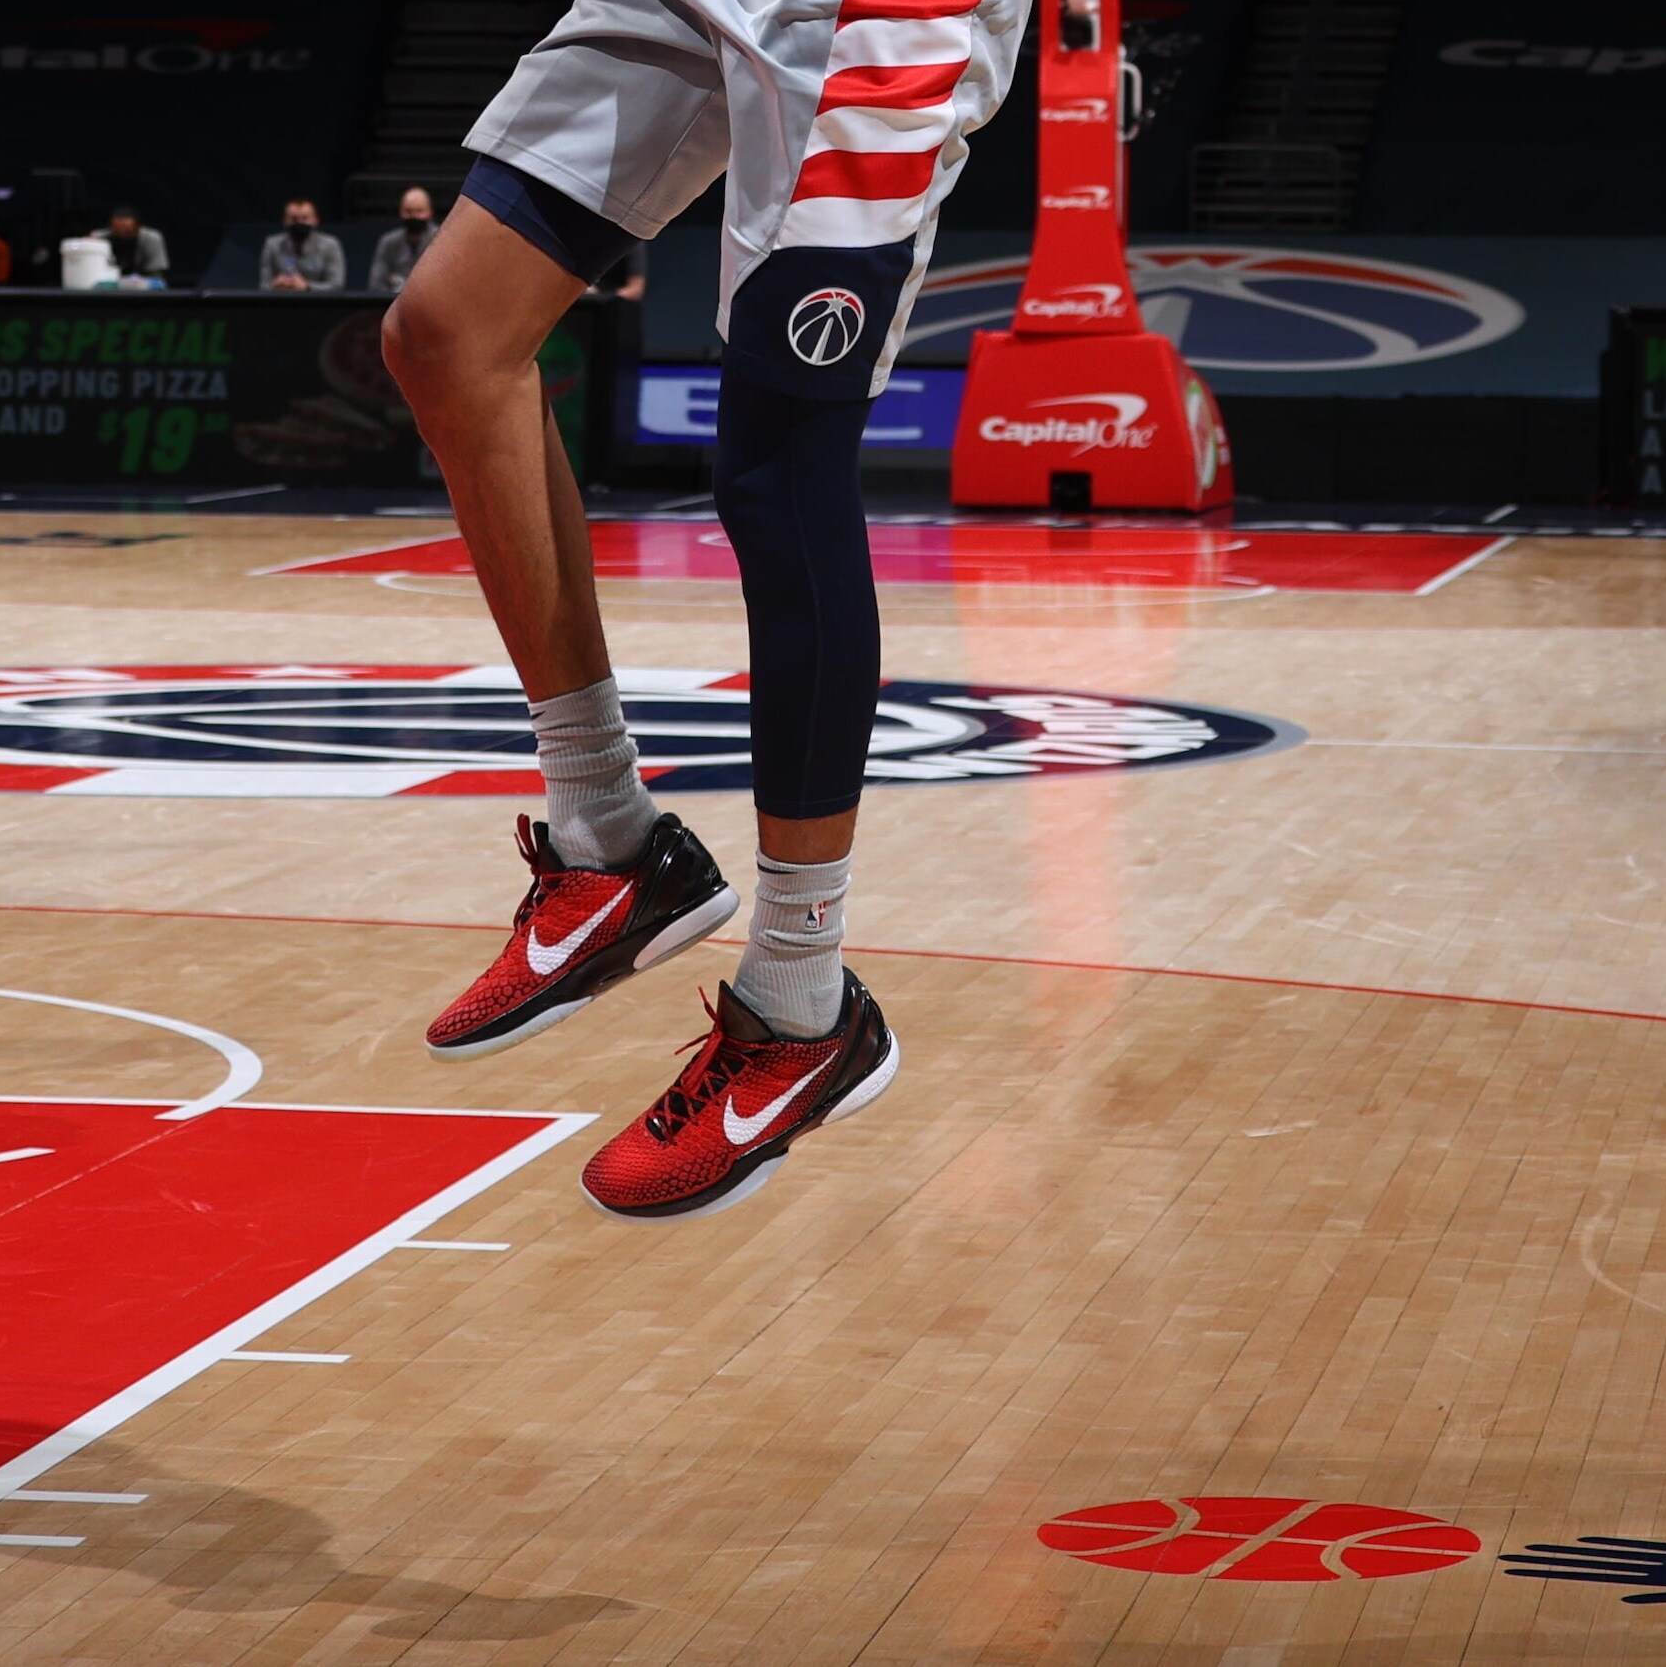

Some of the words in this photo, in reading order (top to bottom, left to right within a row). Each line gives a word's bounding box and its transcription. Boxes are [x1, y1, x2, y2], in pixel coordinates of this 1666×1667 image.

[43, 320, 232, 366] SPECIAL
[133, 370, 228, 401] PIZZA
[1640, 428, 1662, 459] A
[1640, 466, 1663, 497] A
